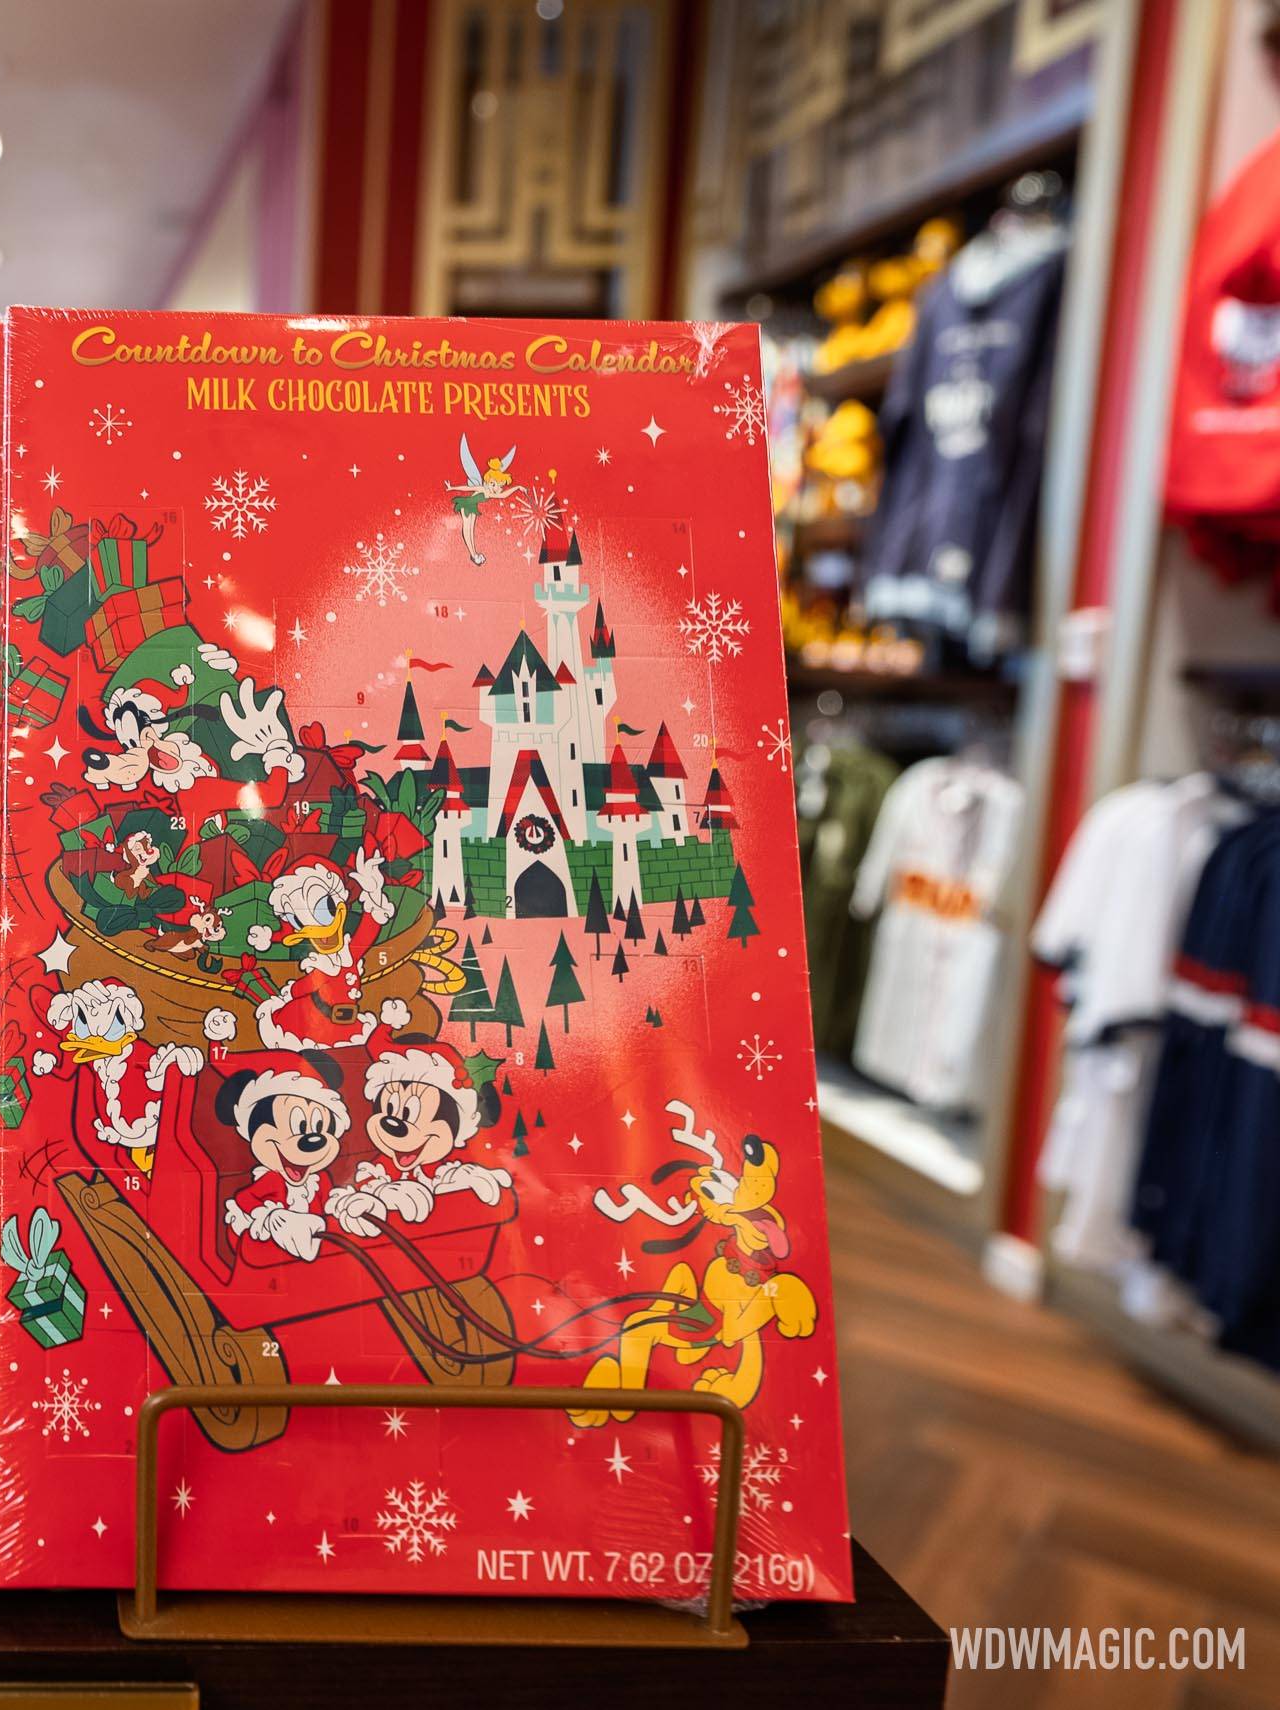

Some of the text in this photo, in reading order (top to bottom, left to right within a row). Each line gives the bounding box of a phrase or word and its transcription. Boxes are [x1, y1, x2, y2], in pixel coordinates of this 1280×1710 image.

[71, 326, 696, 374] Countdown to Christmas Calendar
[187, 377, 591, 421] MILK CHOCOLATE PRESENTS
[433, 606, 449, 619] 18
[356, 691, 366, 706] 9
[693, 734, 709, 749] 20
[293, 801, 310, 816] 19
[170, 816, 187, 832] 23
[693, 810, 702, 824] 7
[505, 895, 513, 909] 2
[378, 952, 388, 967] 5
[682, 959, 698, 973] 13
[211, 1046, 229, 1061] 17
[515, 1051, 524, 1066] 8
[123, 1176, 141, 1191] 15
[762, 1282, 779, 1297] 12
[262, 1341, 280, 1357] 22
[778, 1448, 788, 1464] 3
[476, 1549, 815, 1592] NET WT. 7.62 OZ 216g)
